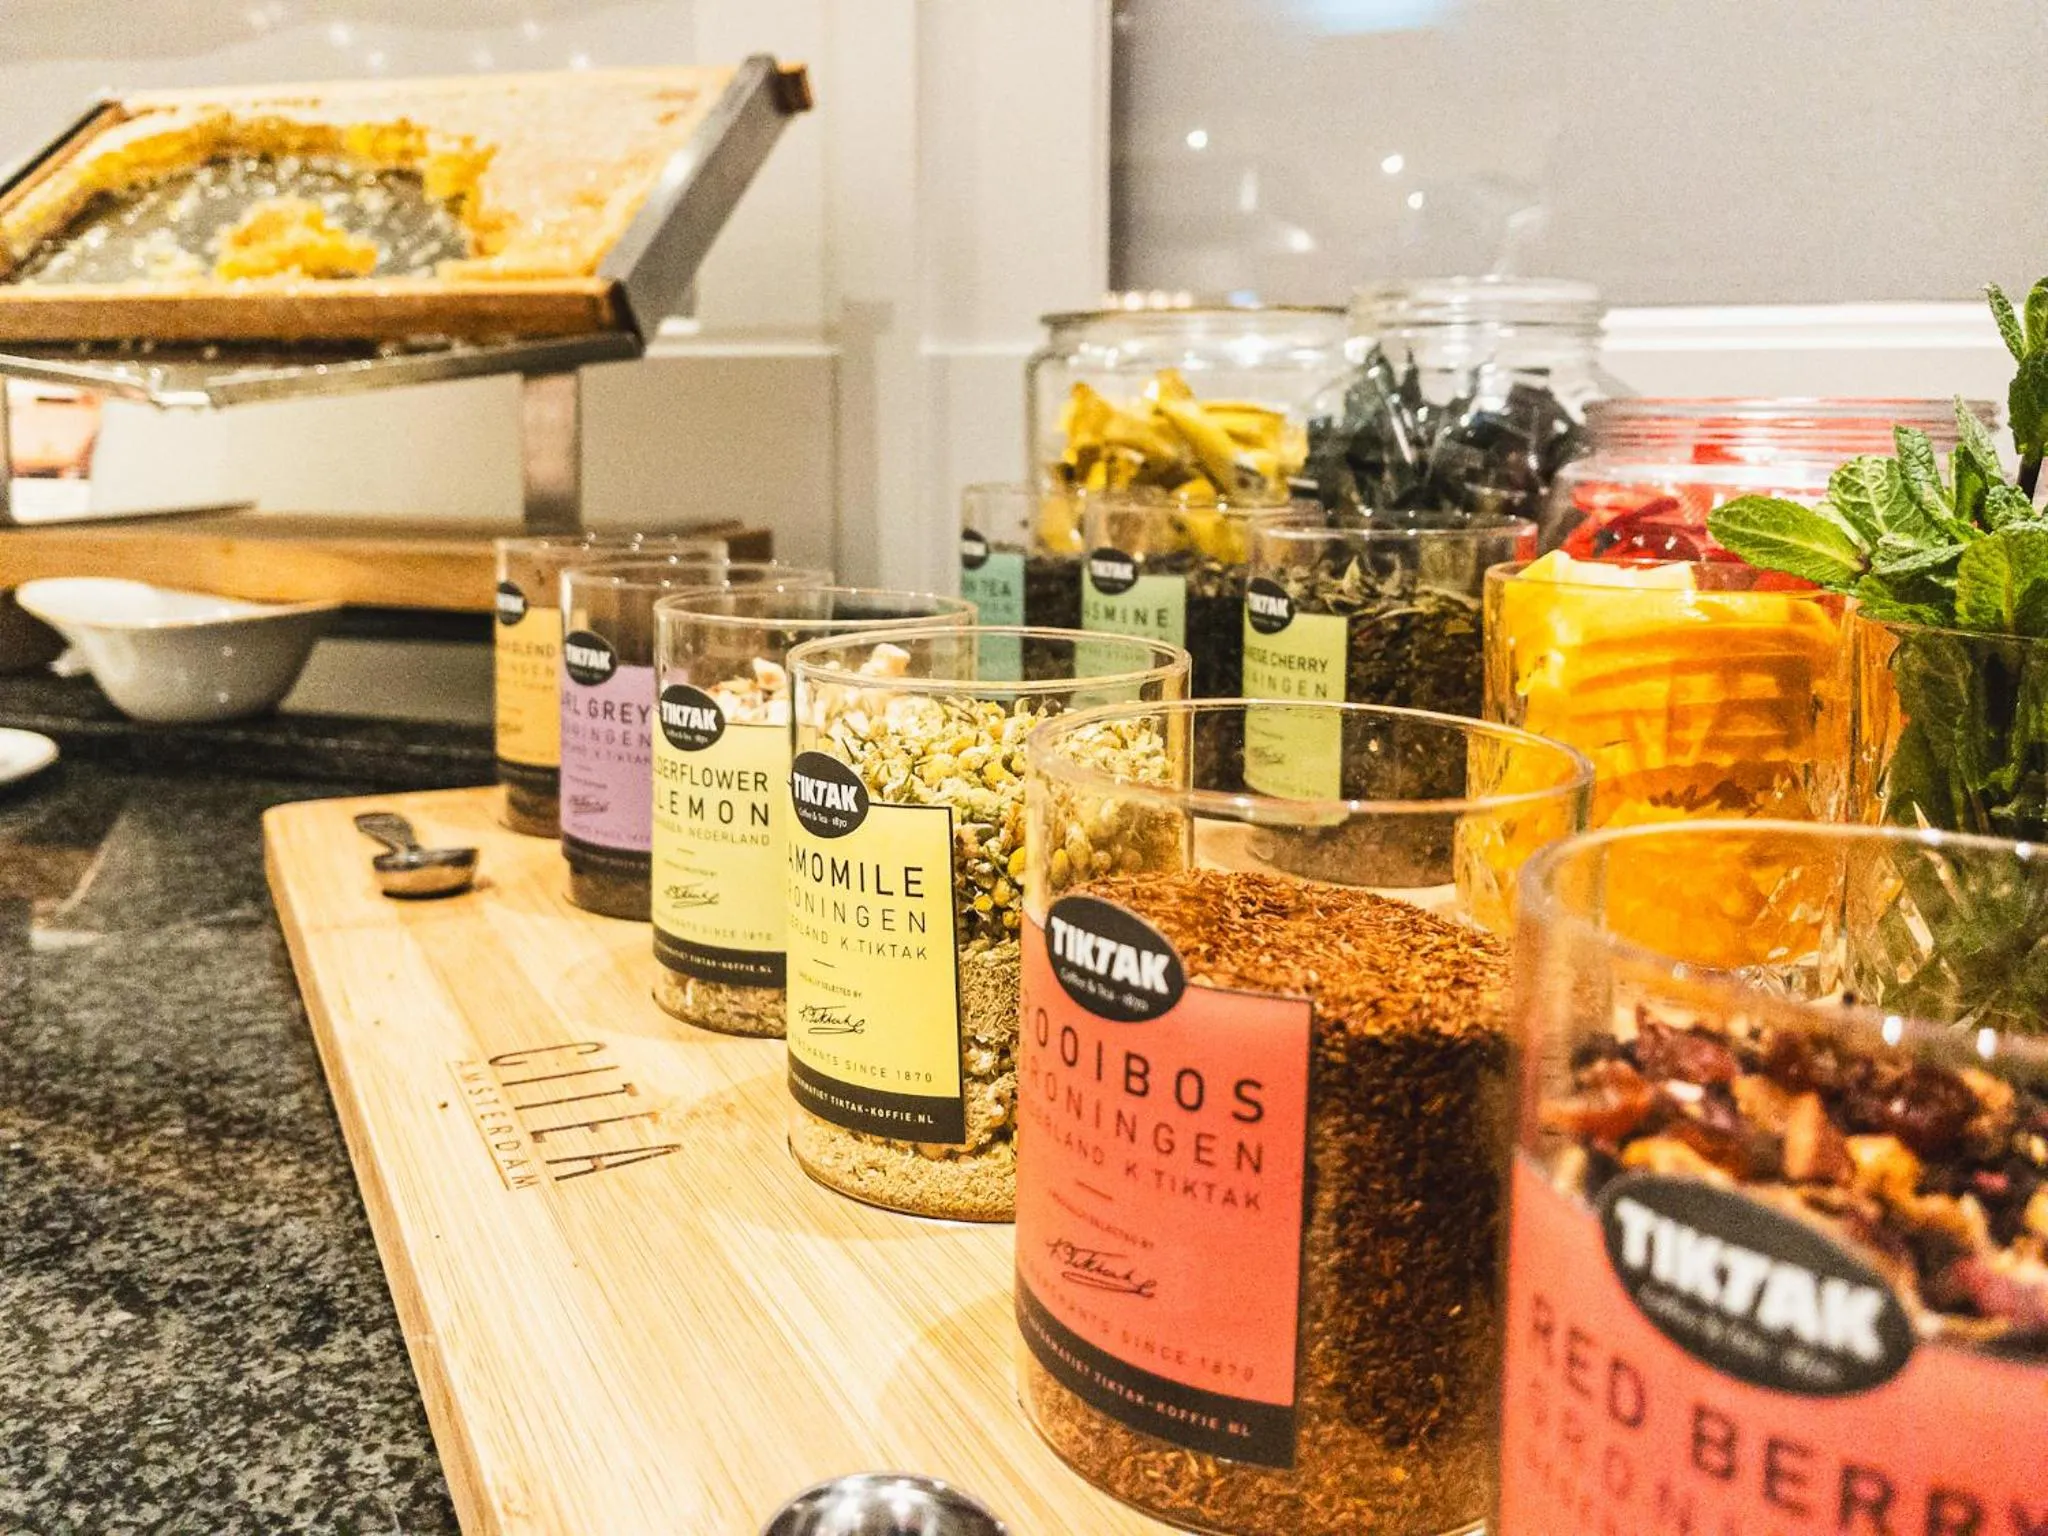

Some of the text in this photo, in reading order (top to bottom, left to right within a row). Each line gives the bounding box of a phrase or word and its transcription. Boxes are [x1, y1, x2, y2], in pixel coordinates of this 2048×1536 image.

[1270, 651, 1329, 673] CHERRY
[587, 698, 652, 725] GREY
[661, 701, 718, 732] TIKTAK
[656, 784, 770, 828] LEMON
[793, 772, 858, 813] TIKTAK
[839, 937, 849, 952] K
[857, 939, 929, 961] TIKTAK
[1050, 915, 1170, 995] TIKTAK
[845, 1059, 888, 1079] SINCE
[896, 1069, 933, 1084] 1870
[830, 1095, 935, 1126] TIKTAK-KOFFIE.NL
[1124, 1160, 1138, 1181] K
[1151, 1168, 1261, 1212] TIKTAK
[1614, 1198, 1886, 1363] TIKTAK
[1121, 1330, 1189, 1366] SINCE
[1531, 1292, 1648, 1431] RED
[1093, 1370, 1252, 1438] TIKTAK-KOFFIE.NL
